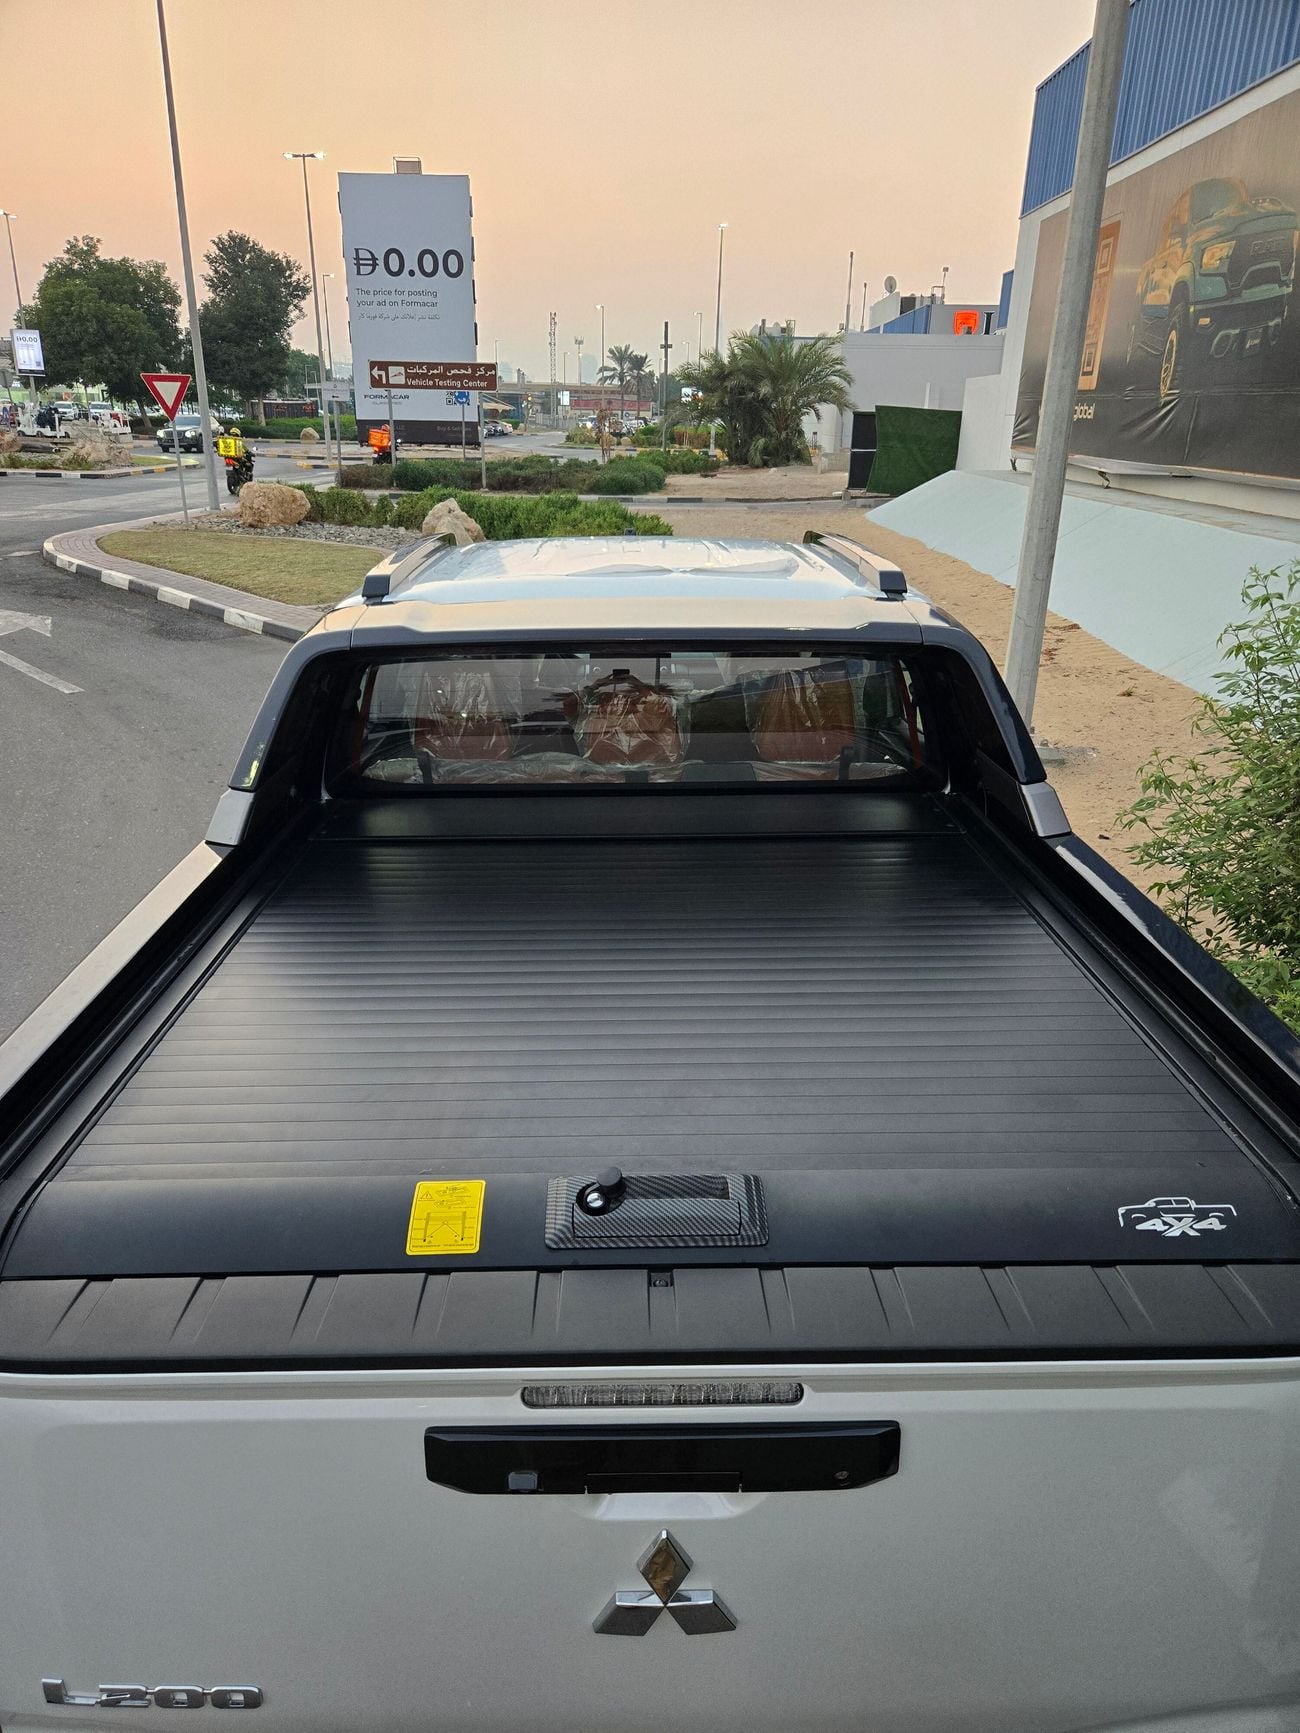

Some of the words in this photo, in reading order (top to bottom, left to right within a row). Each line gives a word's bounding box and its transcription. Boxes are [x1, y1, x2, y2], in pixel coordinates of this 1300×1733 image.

[356, 288, 371, 296] The
[373, 288, 392, 297] price
[394, 288, 406, 296] for
[407, 289, 438, 298] posting
[356, 299, 374, 307] your
[376, 299, 387, 307] ad
[401, 299, 438, 308] Formacar
[406, 364, 444, 376] المركبات
[446, 364, 472, 376] فحص
[475, 365, 496, 376] مركز
[406, 378, 434, 387] Vehicle
[434, 379, 461, 388] Testing
[463, 379, 488, 388] Center
[41, 1678, 263, 1709] L200
